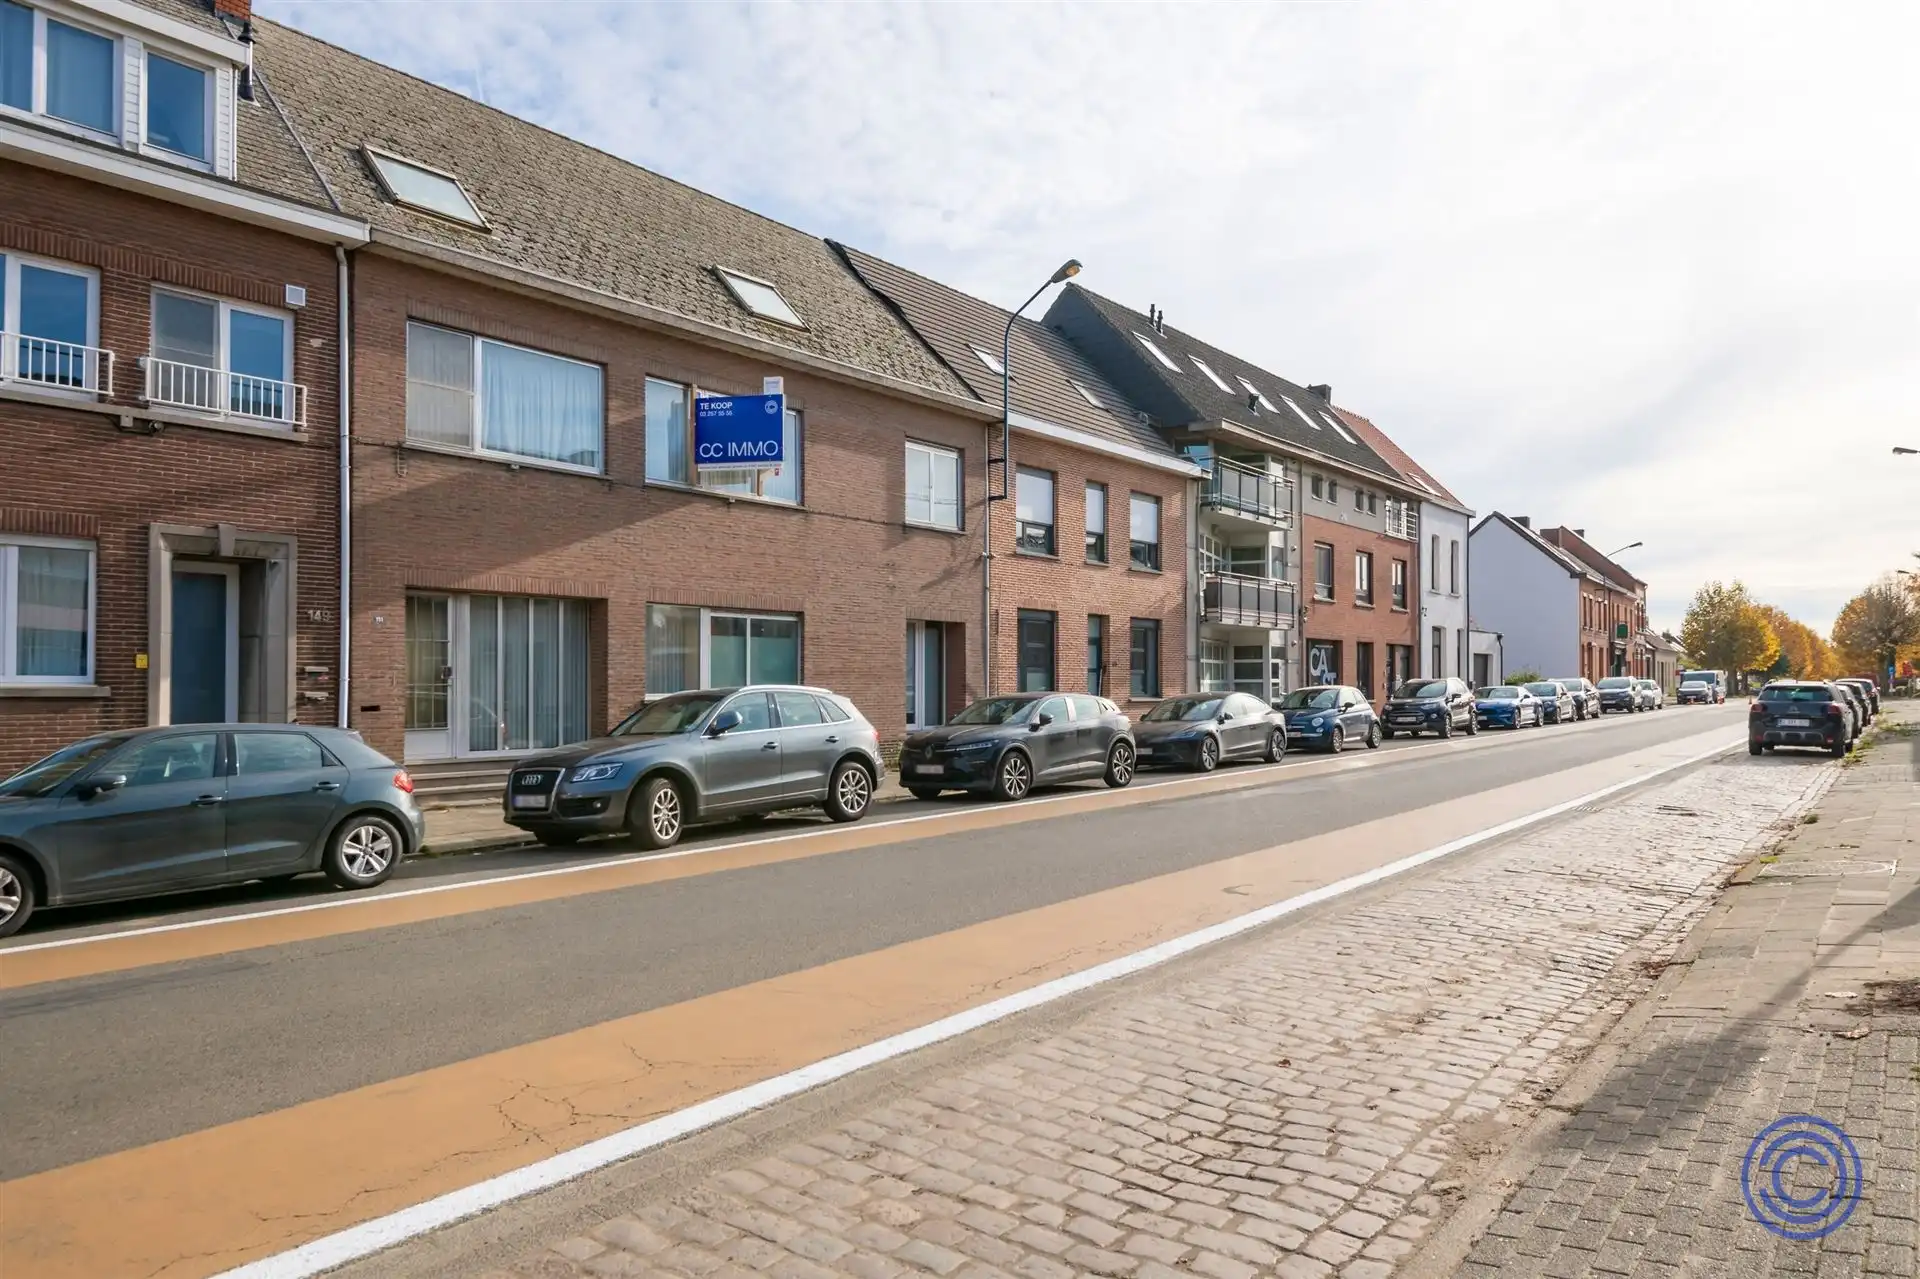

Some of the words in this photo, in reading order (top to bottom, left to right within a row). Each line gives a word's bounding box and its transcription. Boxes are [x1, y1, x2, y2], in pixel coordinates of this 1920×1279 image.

[711, 402, 732, 410] KOOP
[700, 443, 723, 458] CC
[728, 440, 778, 456] IMMO
